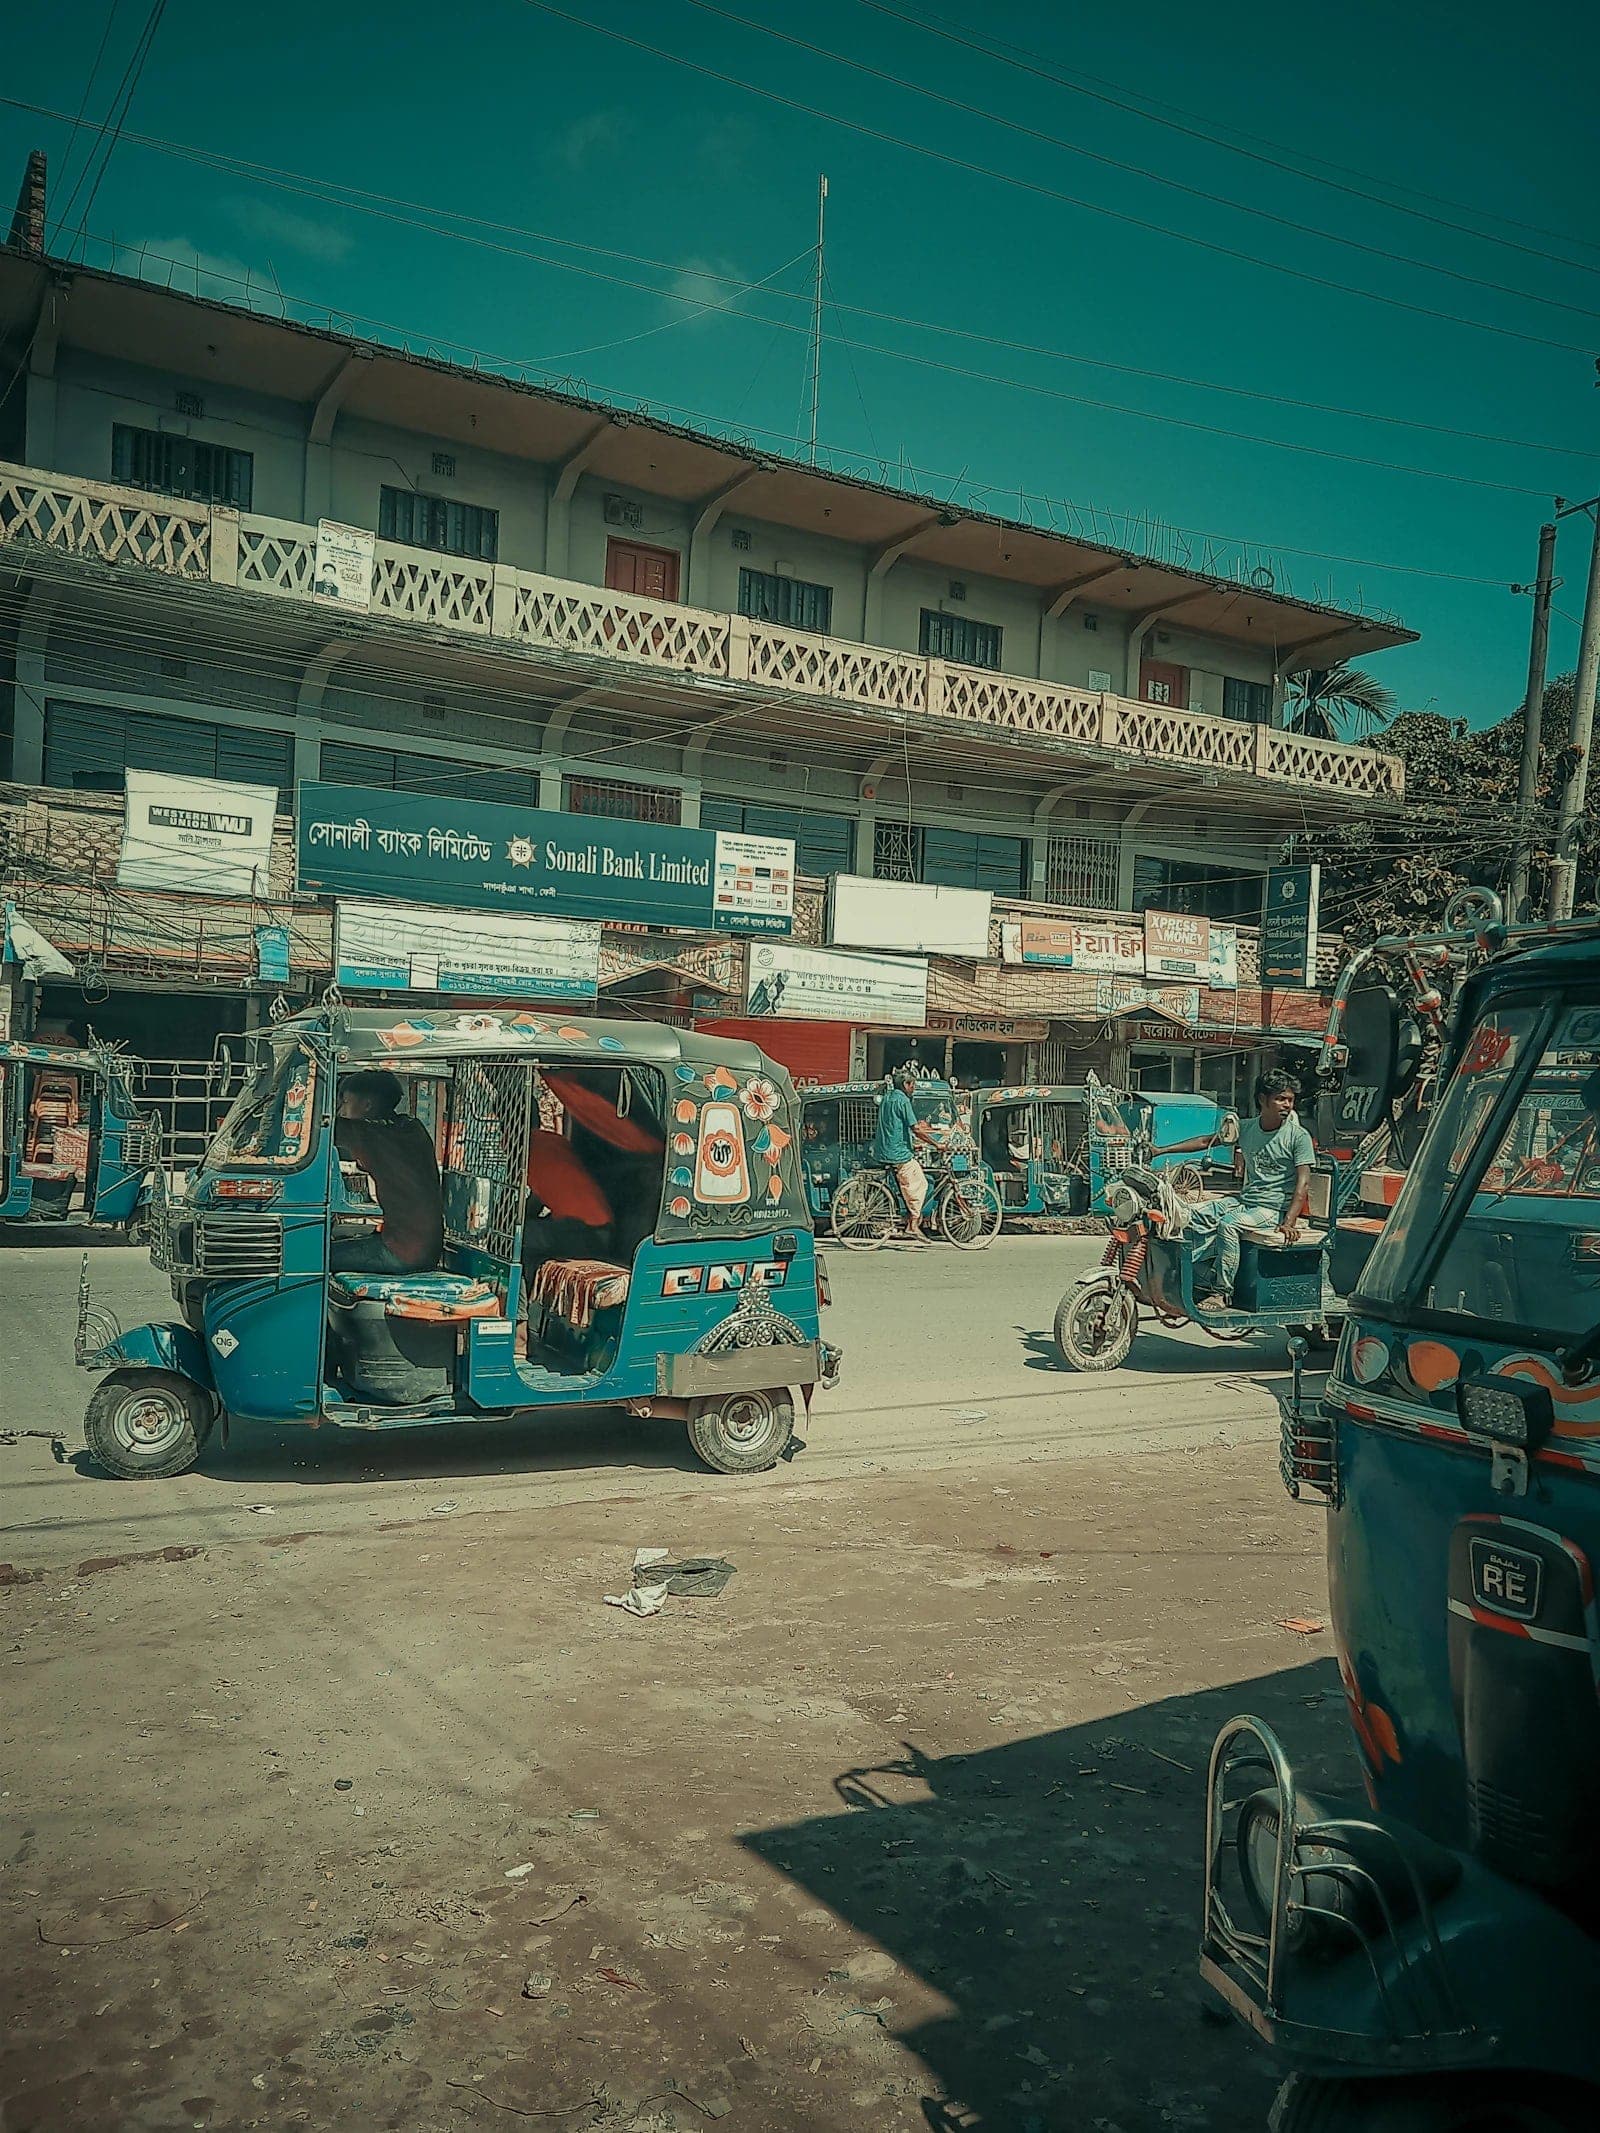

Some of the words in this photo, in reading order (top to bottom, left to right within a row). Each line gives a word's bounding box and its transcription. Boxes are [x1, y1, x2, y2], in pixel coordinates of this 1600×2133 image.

[151, 807, 209, 822] WESTERN
[169, 817, 209, 830] UNION
[216, 815, 249, 834] WU
[309, 818, 372, 850] সোনালী
[376, 829, 422, 857] ব্যাংক
[428, 827, 493, 861] লিমিটেড
[545, 841, 597, 875] Sonali
[602, 847, 645, 880] Bank
[649, 852, 710, 886] Limited
[539, 886, 556, 898] ফেনী
[1151, 915, 1198, 933] XPRESS
[1164, 929, 1205, 947] MONEY
[796, 970, 818, 981] wires
[819, 973, 847, 984] without
[848, 977, 878, 987] worries
[954, 1014, 997, 1032] মেডিকেল
[998, 1021, 1015, 1035] হল
[1143, 1024, 1178, 1039] ঘরোয়া
[661, 1260, 789, 1297] CNG
[216, 1337, 233, 1347] CNG
[1490, 1555, 1520, 1570] BAJAJ
[1483, 1563, 1527, 1604] RE
